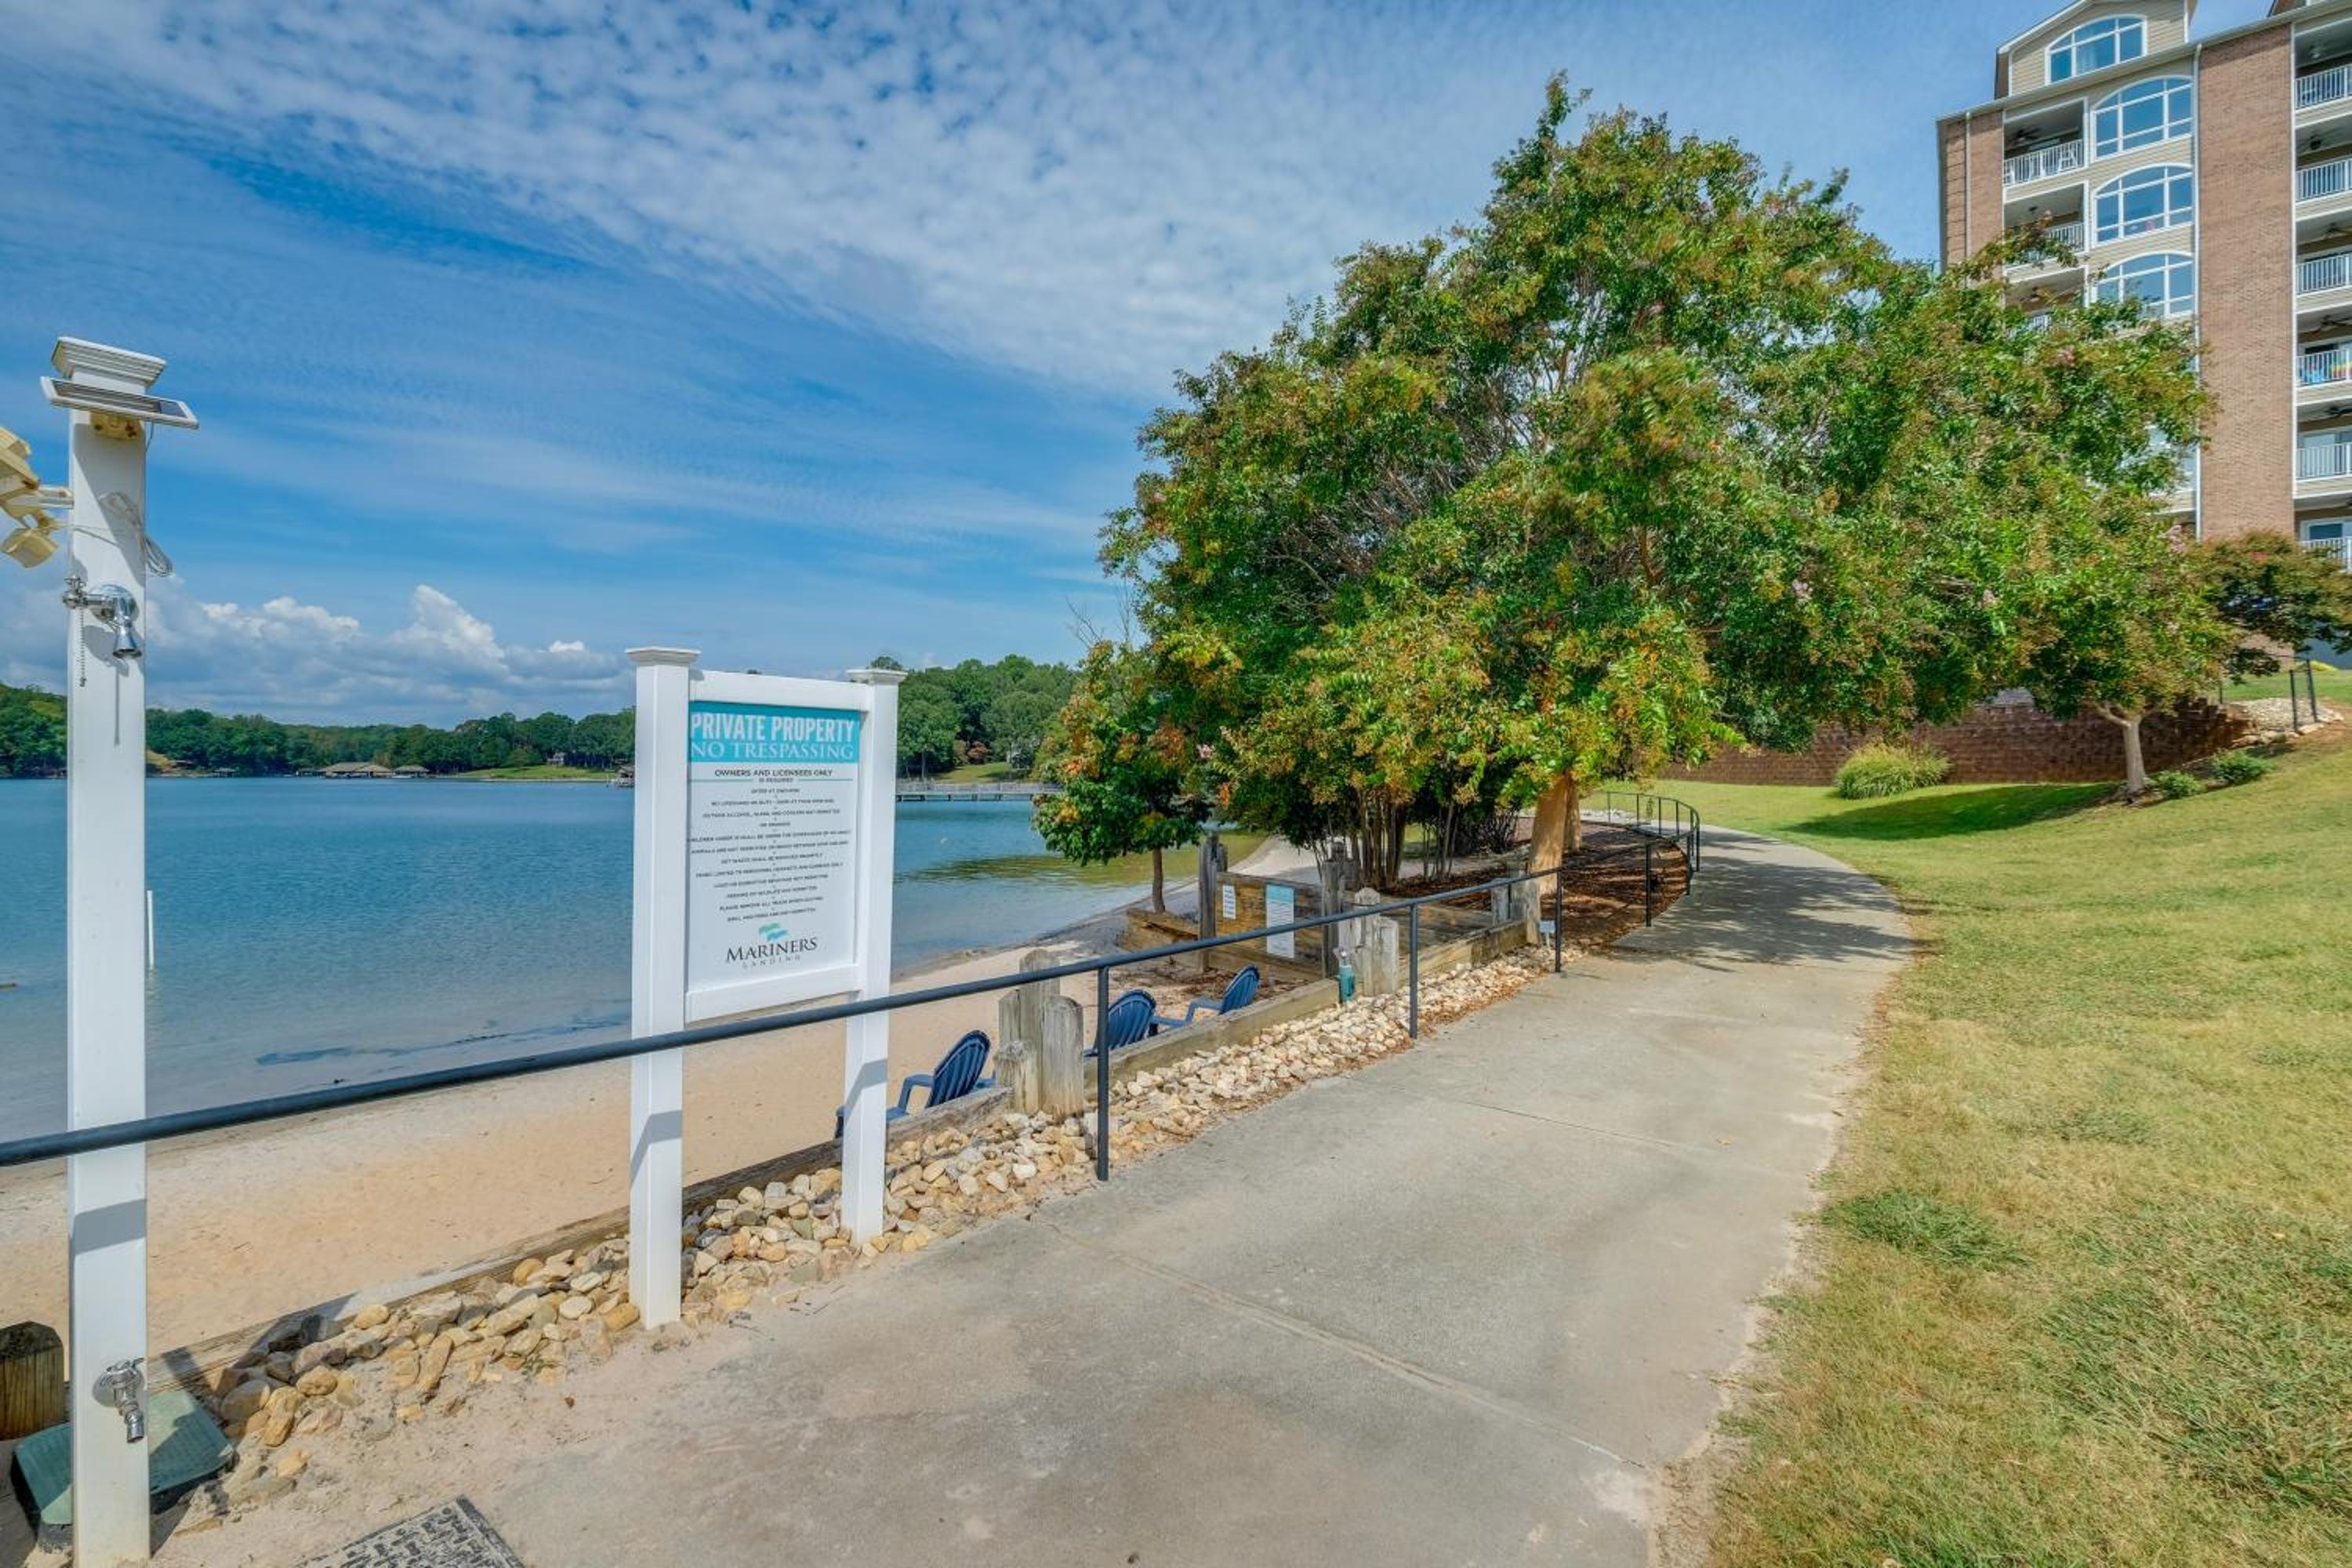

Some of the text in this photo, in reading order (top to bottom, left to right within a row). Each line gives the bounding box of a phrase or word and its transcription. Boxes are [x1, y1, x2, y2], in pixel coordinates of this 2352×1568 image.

[691, 712, 854, 742] PRIVATE PROPERTY
[691, 741, 854, 760] NO TRESPASSING
[725, 937, 818, 964] MARINERS
